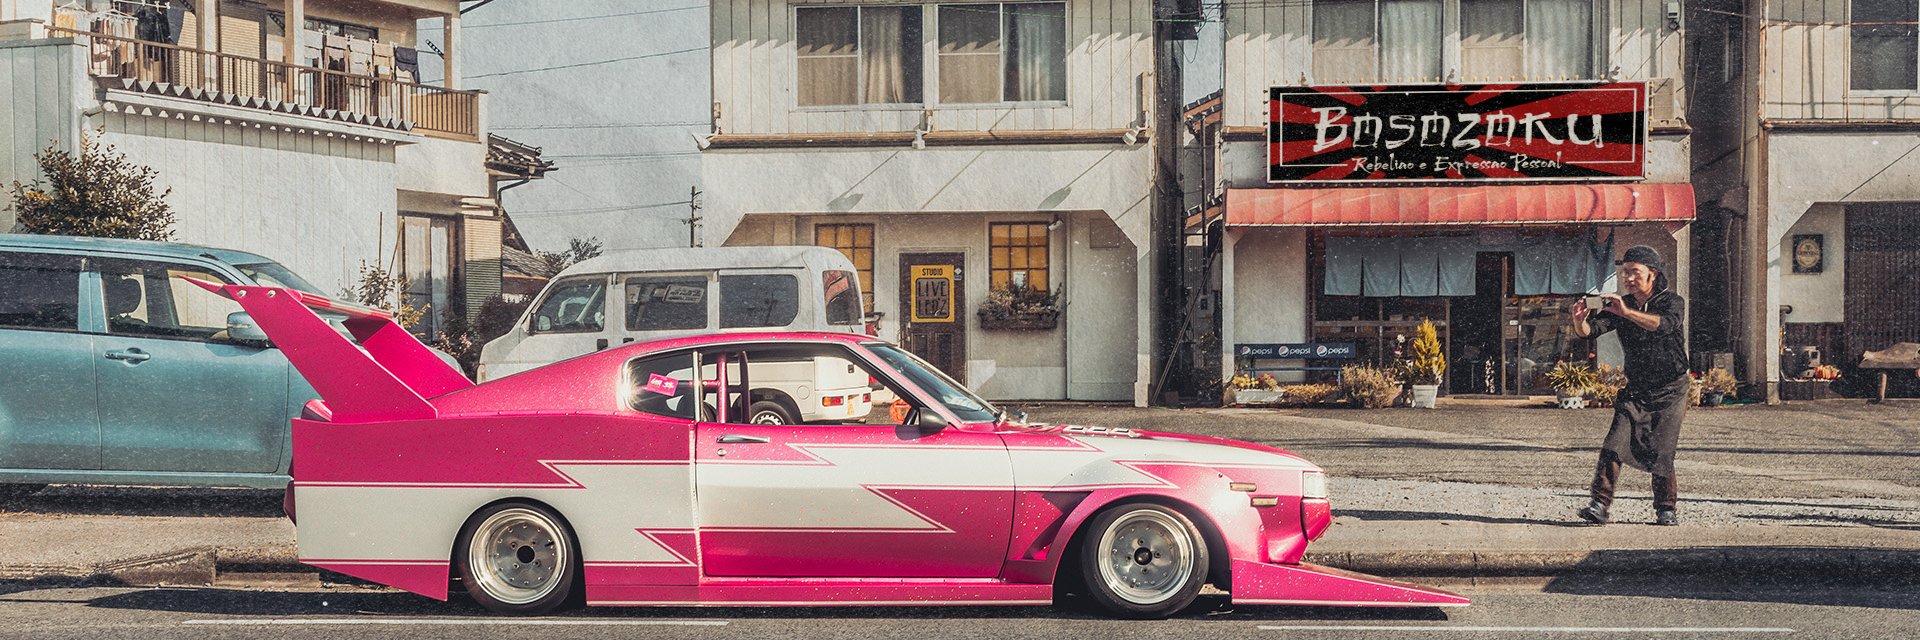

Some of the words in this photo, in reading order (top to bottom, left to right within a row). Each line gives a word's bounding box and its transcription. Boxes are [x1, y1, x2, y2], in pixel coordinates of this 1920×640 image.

[1352, 153, 1414, 174] Rebeliao
[1419, 161, 1427, 170] e
[1434, 156, 1507, 175] Expressao
[1510, 151, 1562, 172] Pessoal
[922, 268, 943, 276] STUDIO
[918, 281, 947, 297] LIVE
[1289, 347, 1311, 355] pepsi
